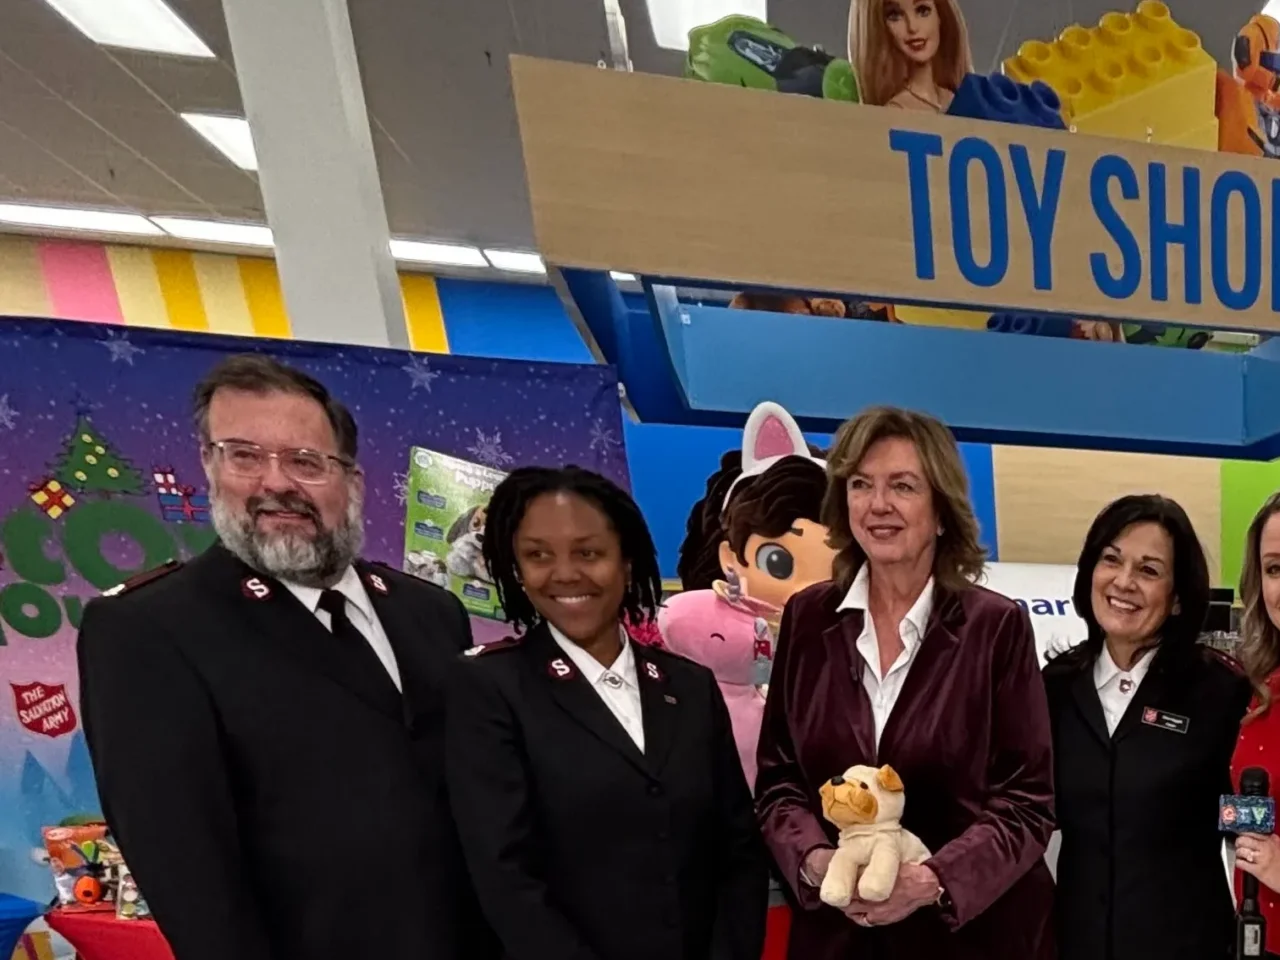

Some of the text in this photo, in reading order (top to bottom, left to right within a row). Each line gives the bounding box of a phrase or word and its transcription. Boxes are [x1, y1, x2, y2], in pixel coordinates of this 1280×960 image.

[889, 129, 1066, 291] TOY
[246, 578, 270, 598] S
[551, 658, 571, 677] S
[646, 662, 660, 679] S
[21, 685, 45, 705] THE
[19, 690, 66, 724] SALVATION
[42, 706, 69, 732] ARMY
